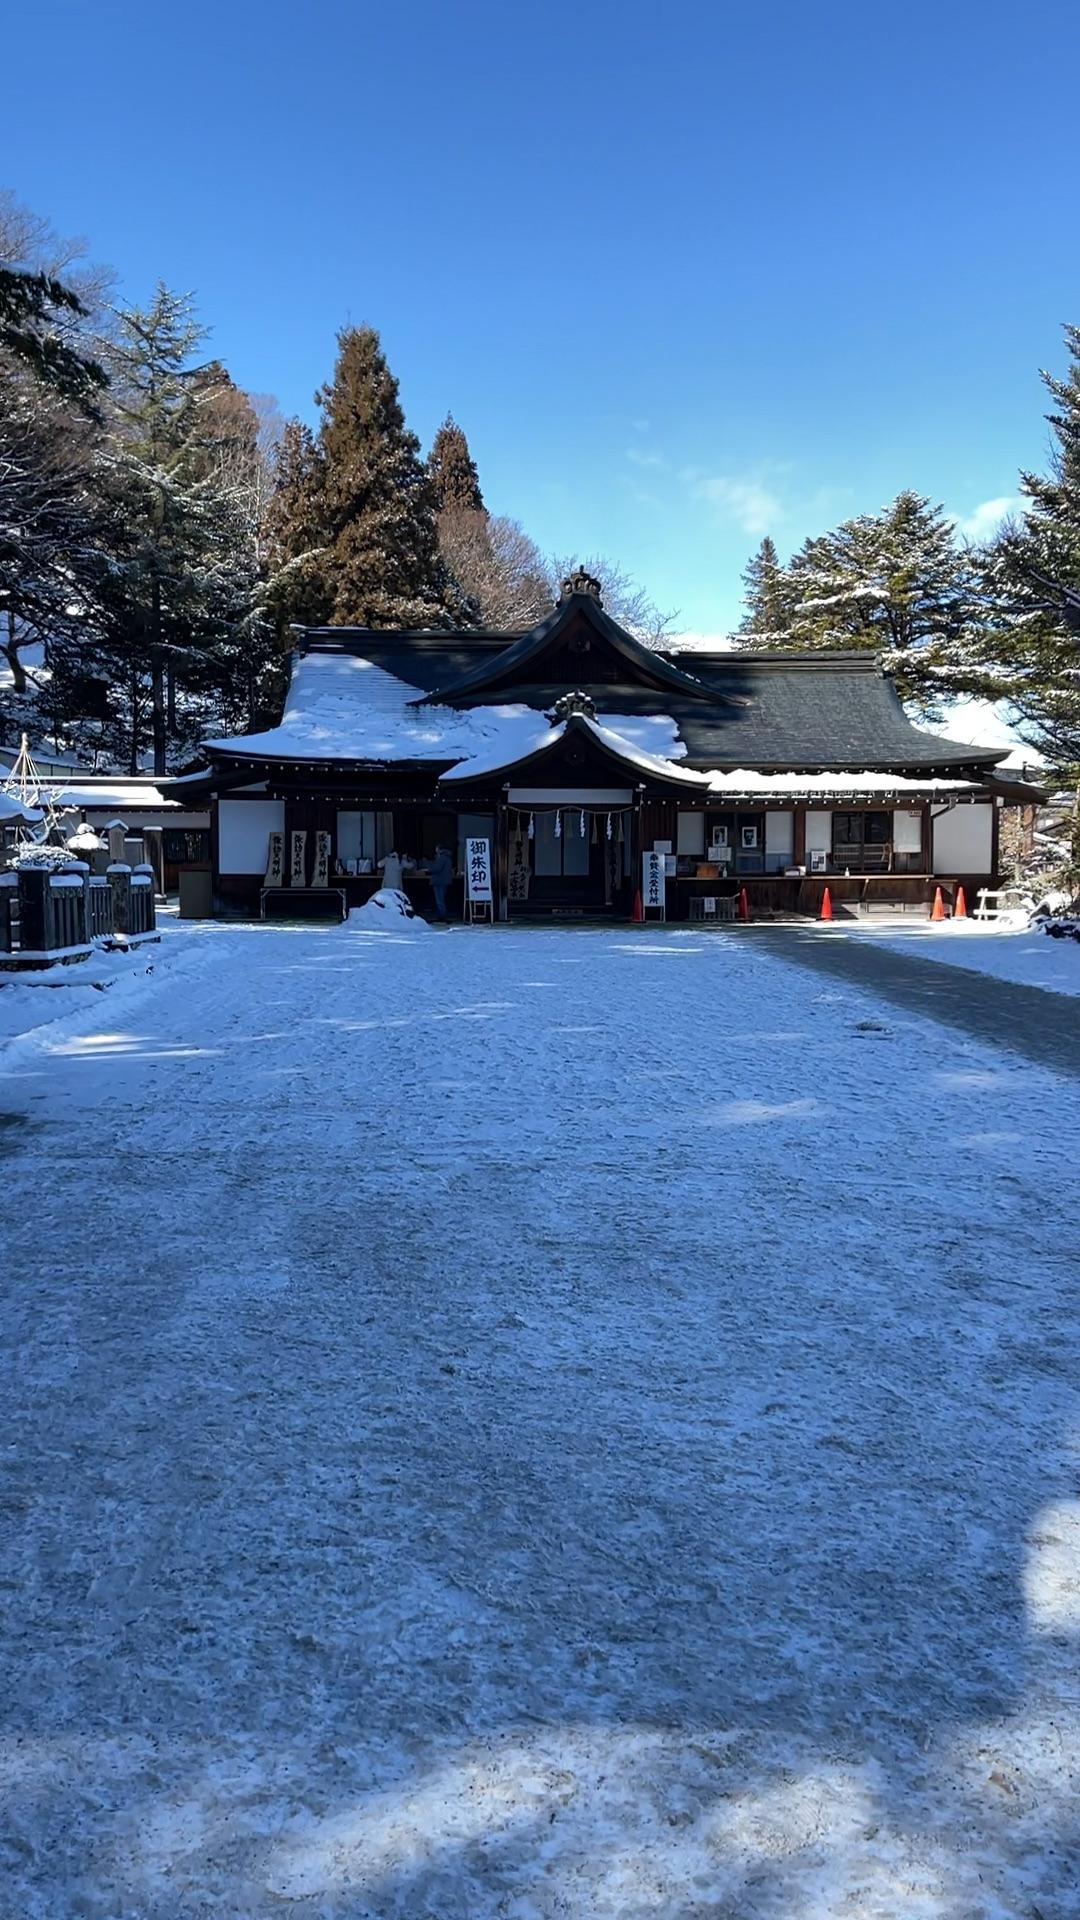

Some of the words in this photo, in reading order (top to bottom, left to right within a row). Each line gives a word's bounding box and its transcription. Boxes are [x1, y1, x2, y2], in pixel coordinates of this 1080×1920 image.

[470, 840, 487, 883] 御朱印
[648, 853, 660, 905] 奉賛金受付所
